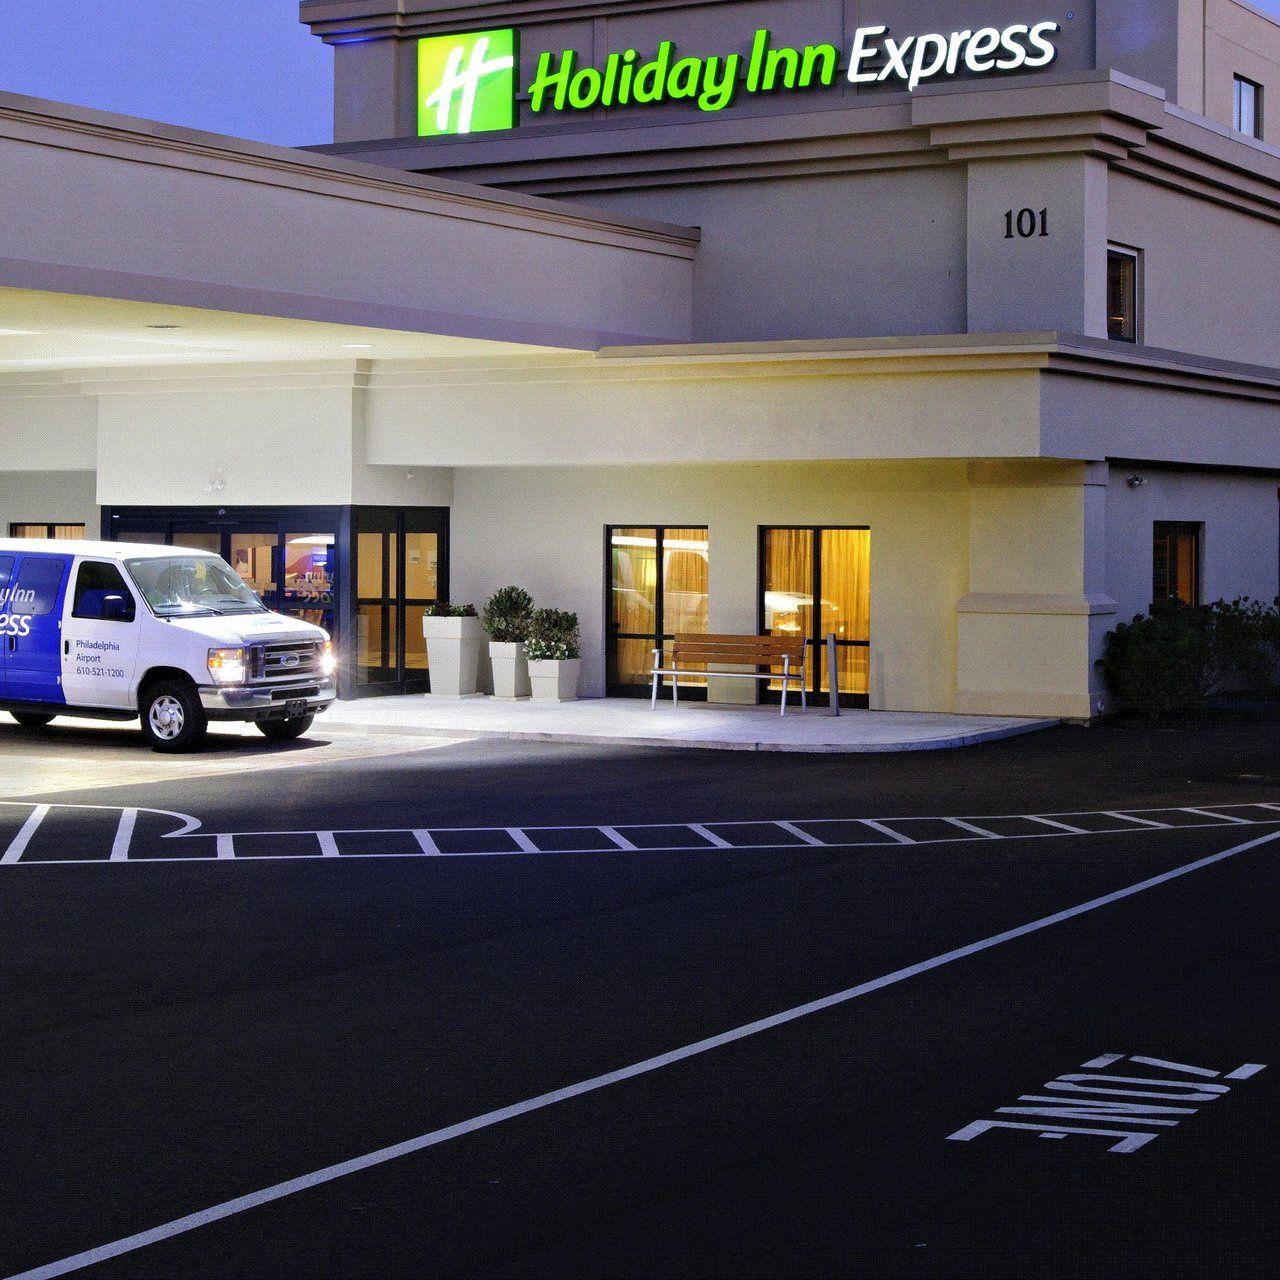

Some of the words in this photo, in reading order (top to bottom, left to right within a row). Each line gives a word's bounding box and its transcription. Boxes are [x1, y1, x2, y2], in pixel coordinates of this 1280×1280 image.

[528, 41, 739, 112] Holiday
[746, 29, 839, 92] Inn
[846, 21, 1058, 91] Express
[1004, 207, 1049, 238] 101
[10, 582, 36, 603] Inn
[76, 639, 120, 651] Philadelphia
[76, 653, 101, 664] Airport
[76, 666, 125, 678] 610-521-1200
[945, 1053, 1269, 1154] ZONE
